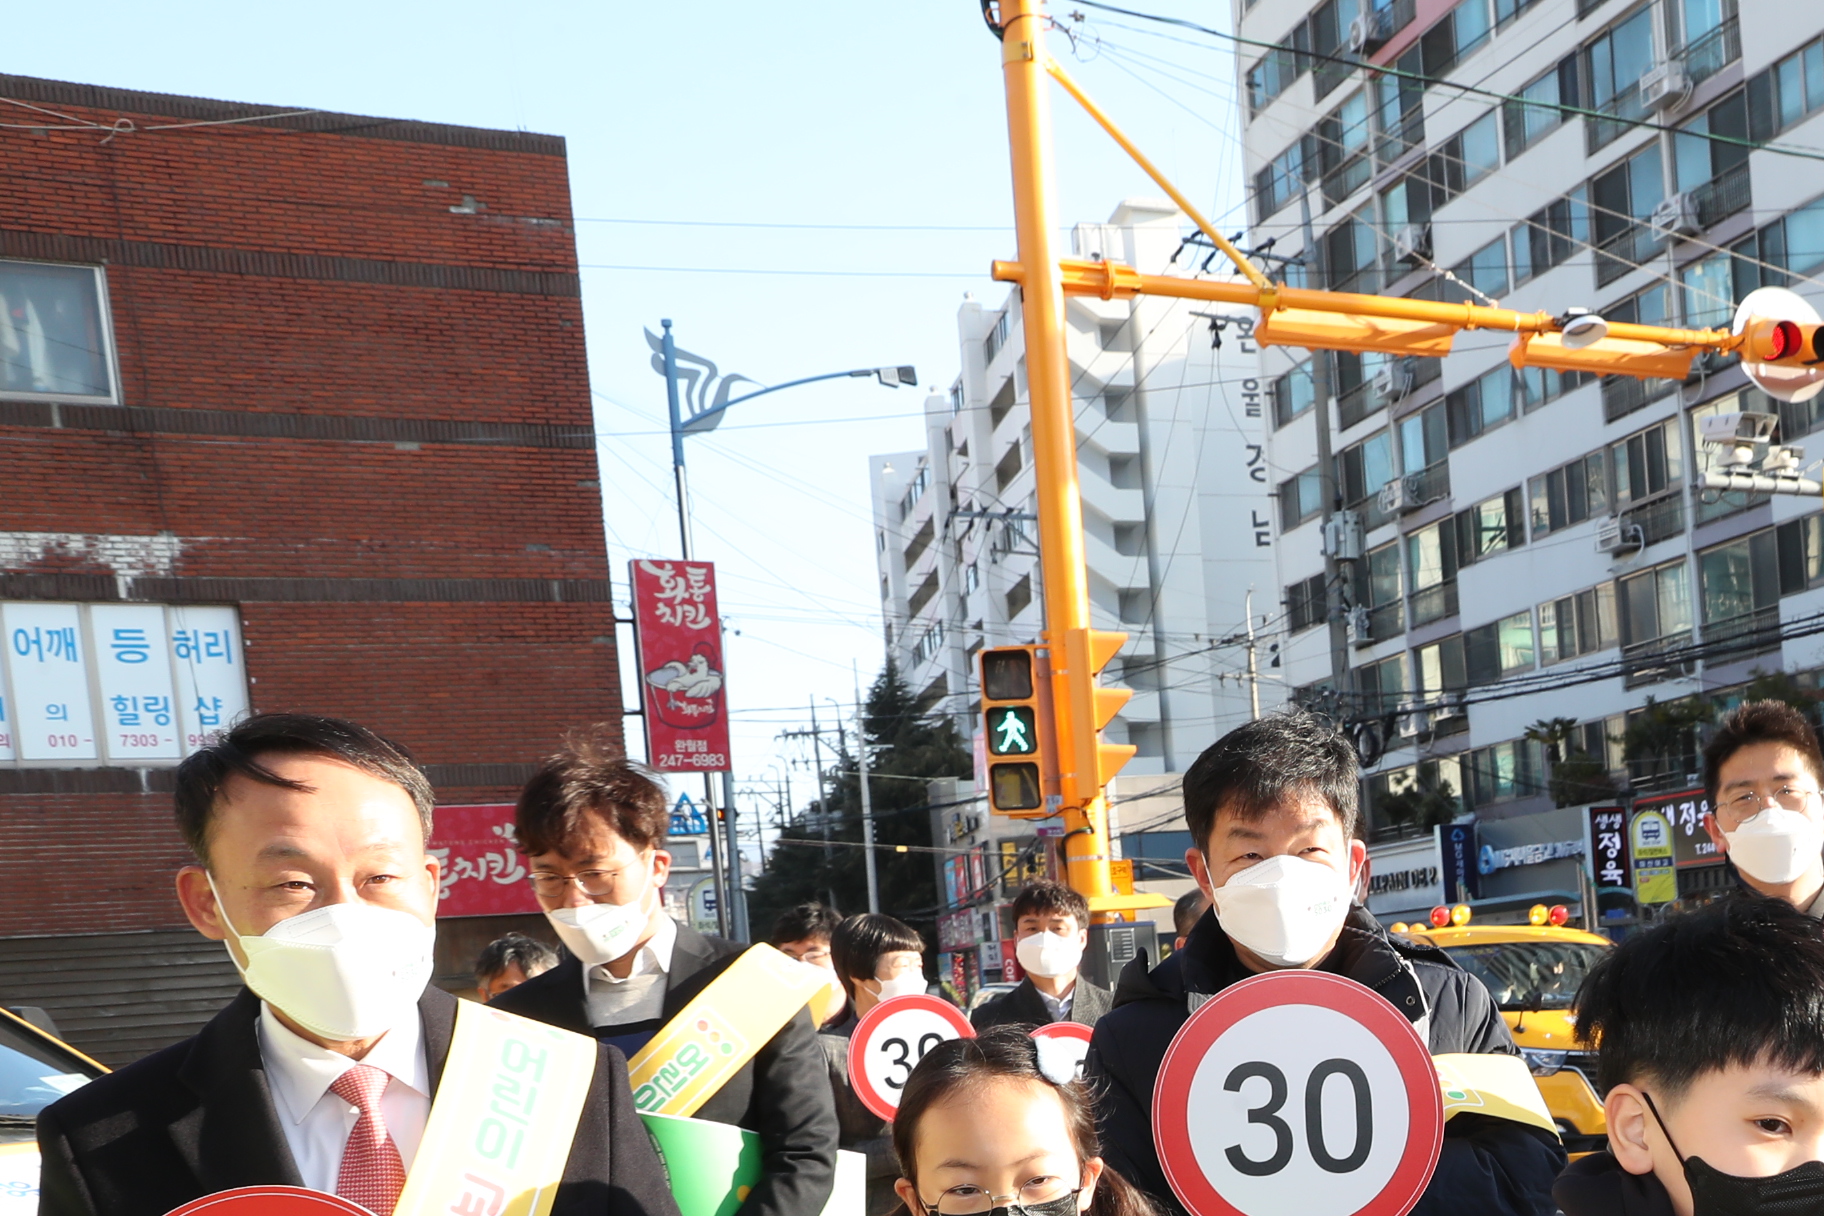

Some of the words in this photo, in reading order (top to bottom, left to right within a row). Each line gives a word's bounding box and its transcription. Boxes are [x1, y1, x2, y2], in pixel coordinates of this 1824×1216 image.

[655, 602, 712, 630] 치킨
[13, 626, 78, 663] 어깨
[110, 628, 151, 664] 등
[172, 629, 233, 664] 허리
[45, 703, 68, 722] 의
[109, 695, 171, 727] 힐링
[193, 696, 223, 726] 샵
[659, 753, 726, 767] 247-6983
[1594, 813, 1623, 830] 생생
[1598, 832, 1625, 887] 정육
[633, 1043, 710, 1112] 어린이
[475, 1038, 548, 1169] 어린이
[1224, 1059, 1373, 1177] 30
